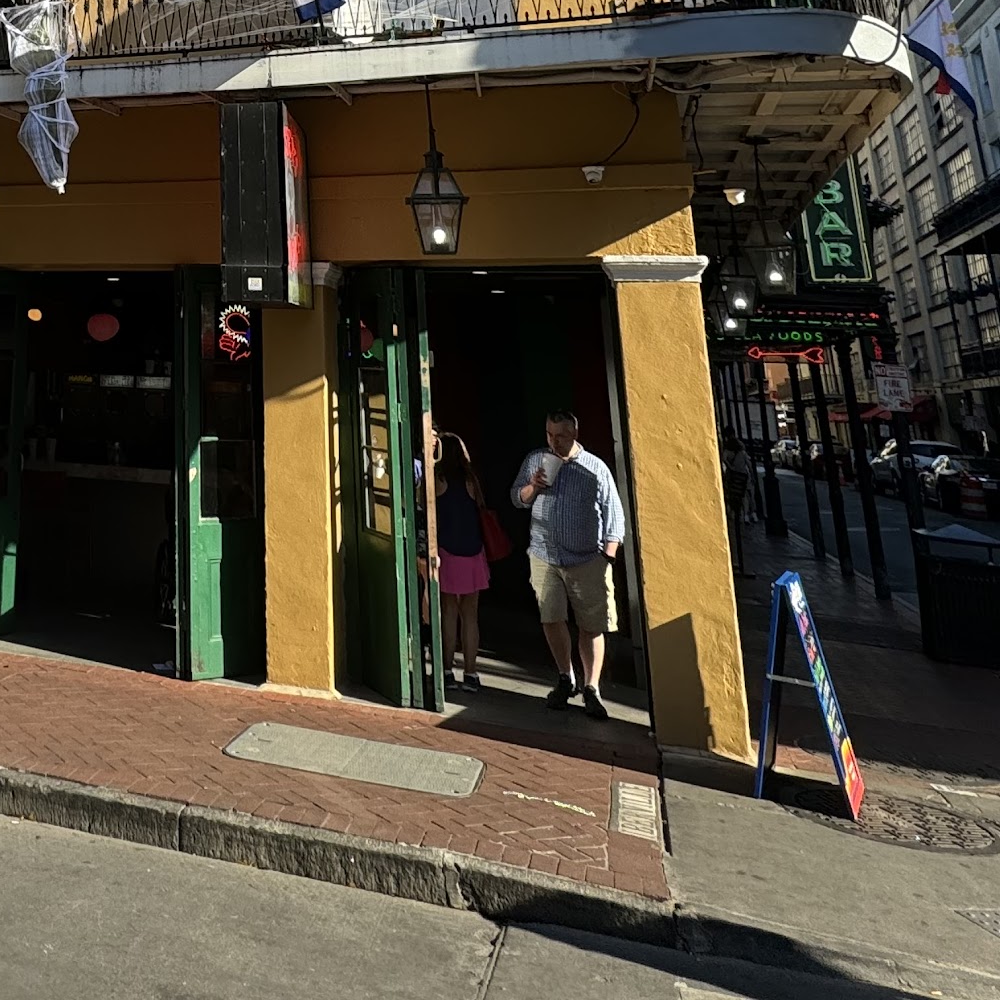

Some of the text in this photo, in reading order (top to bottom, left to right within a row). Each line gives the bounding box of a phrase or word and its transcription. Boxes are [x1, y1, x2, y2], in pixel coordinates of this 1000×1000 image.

[814, 180, 855, 267] BAR
[883, 379, 901, 388] FIRE
[883, 389, 905, 397] LANE
